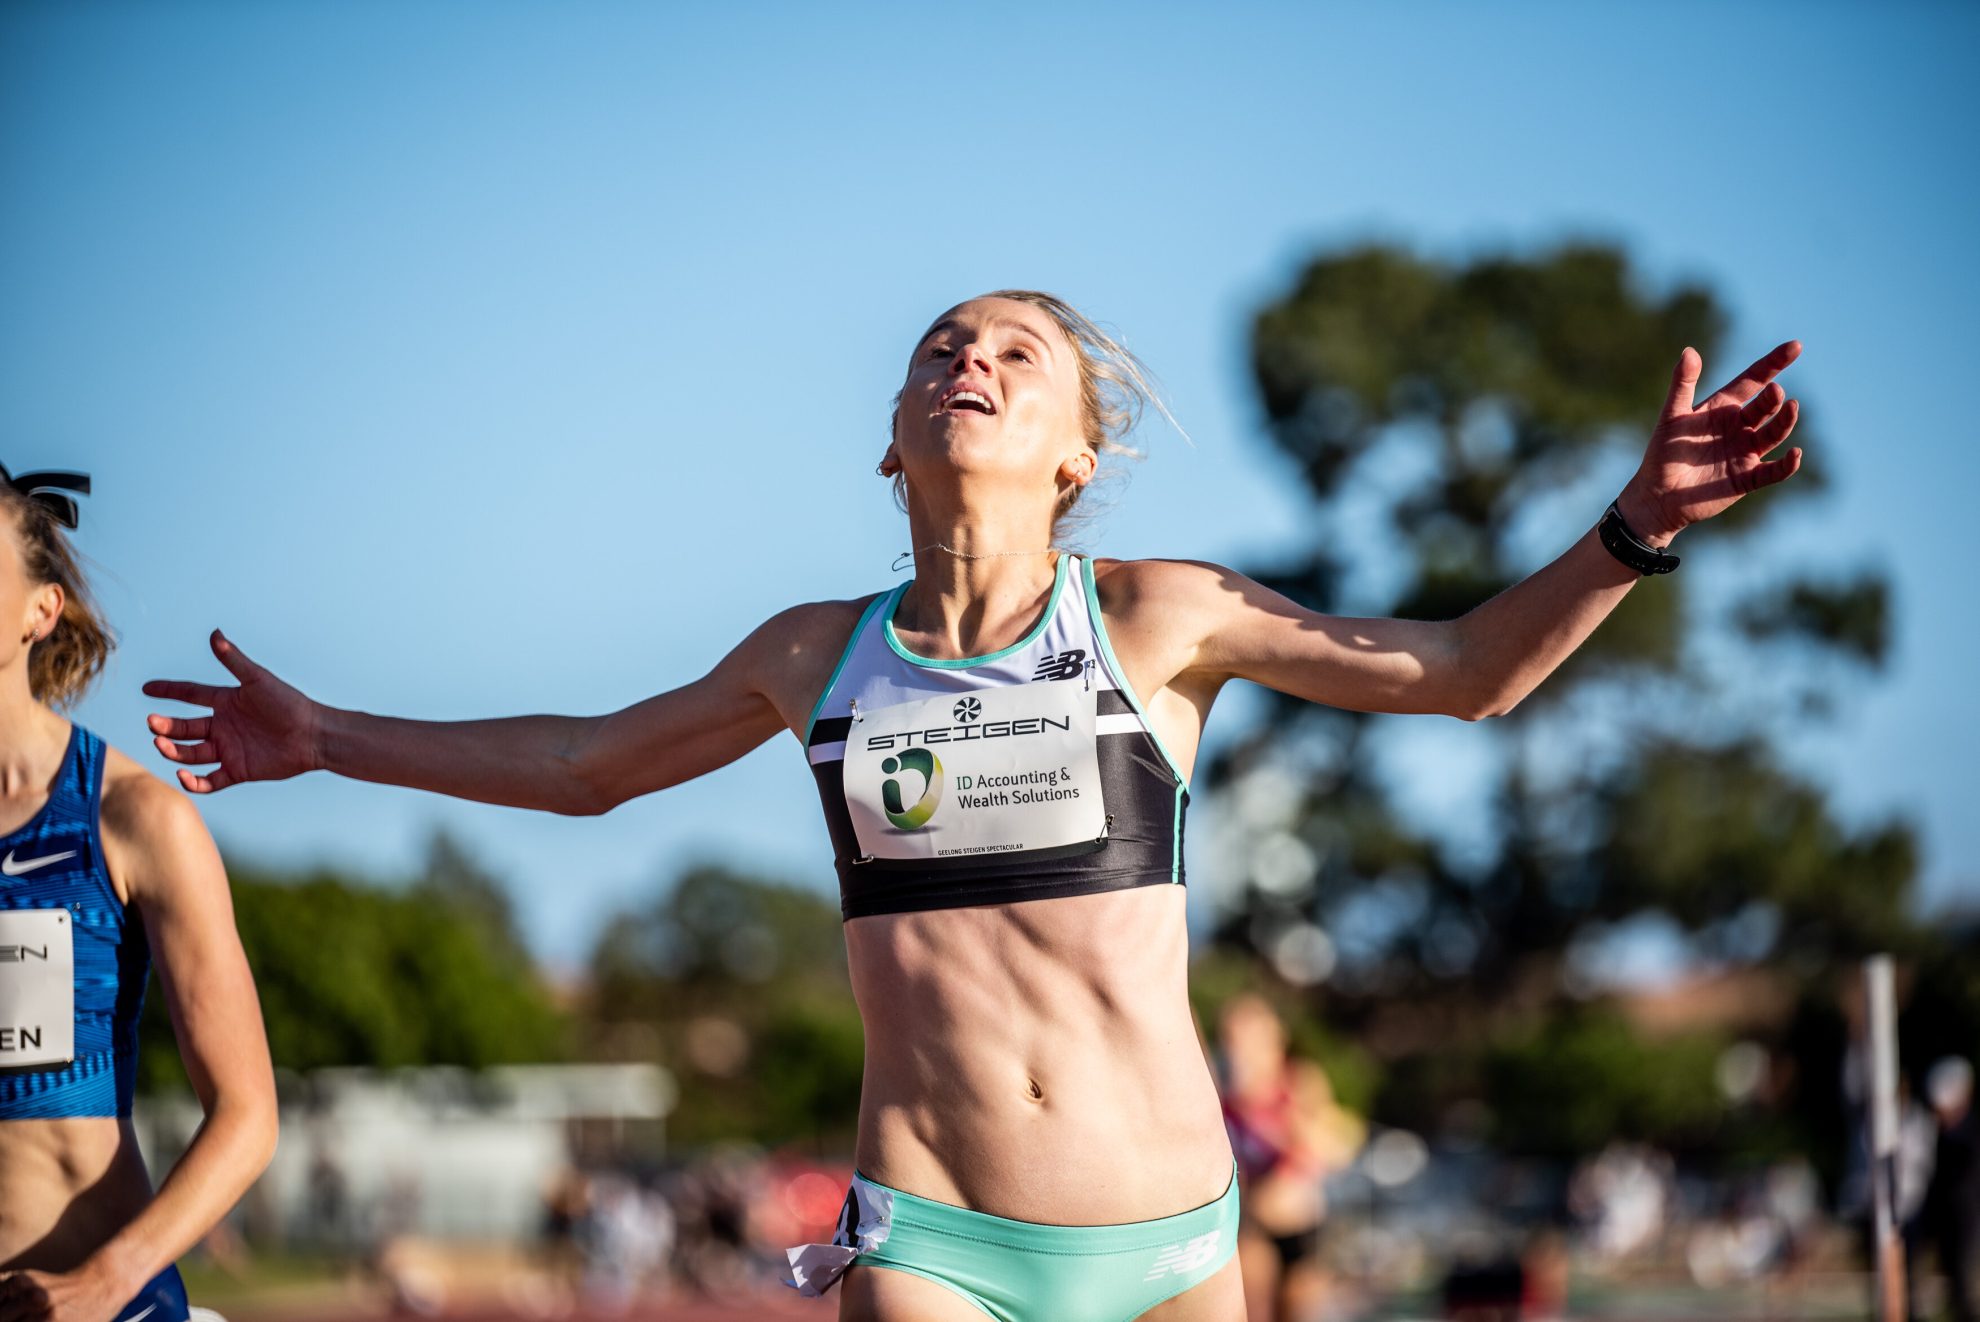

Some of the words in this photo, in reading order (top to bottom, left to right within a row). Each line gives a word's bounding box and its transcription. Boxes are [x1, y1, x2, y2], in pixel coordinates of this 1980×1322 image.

[867, 715, 1070, 751] STEIGEN
[956, 775, 973, 790] ID
[977, 770, 1058, 788] Accounting
[1060, 766, 1071, 781] &
[958, 791, 1009, 809] Wealth
[1012, 788, 1080, 805] Solutions
[937, 848, 963, 856] GEELONG
[963, 846, 986, 855] STEIGEN
[986, 843, 1024, 852] SPECTACULAR
[1143, 1230, 1221, 1281] NB
